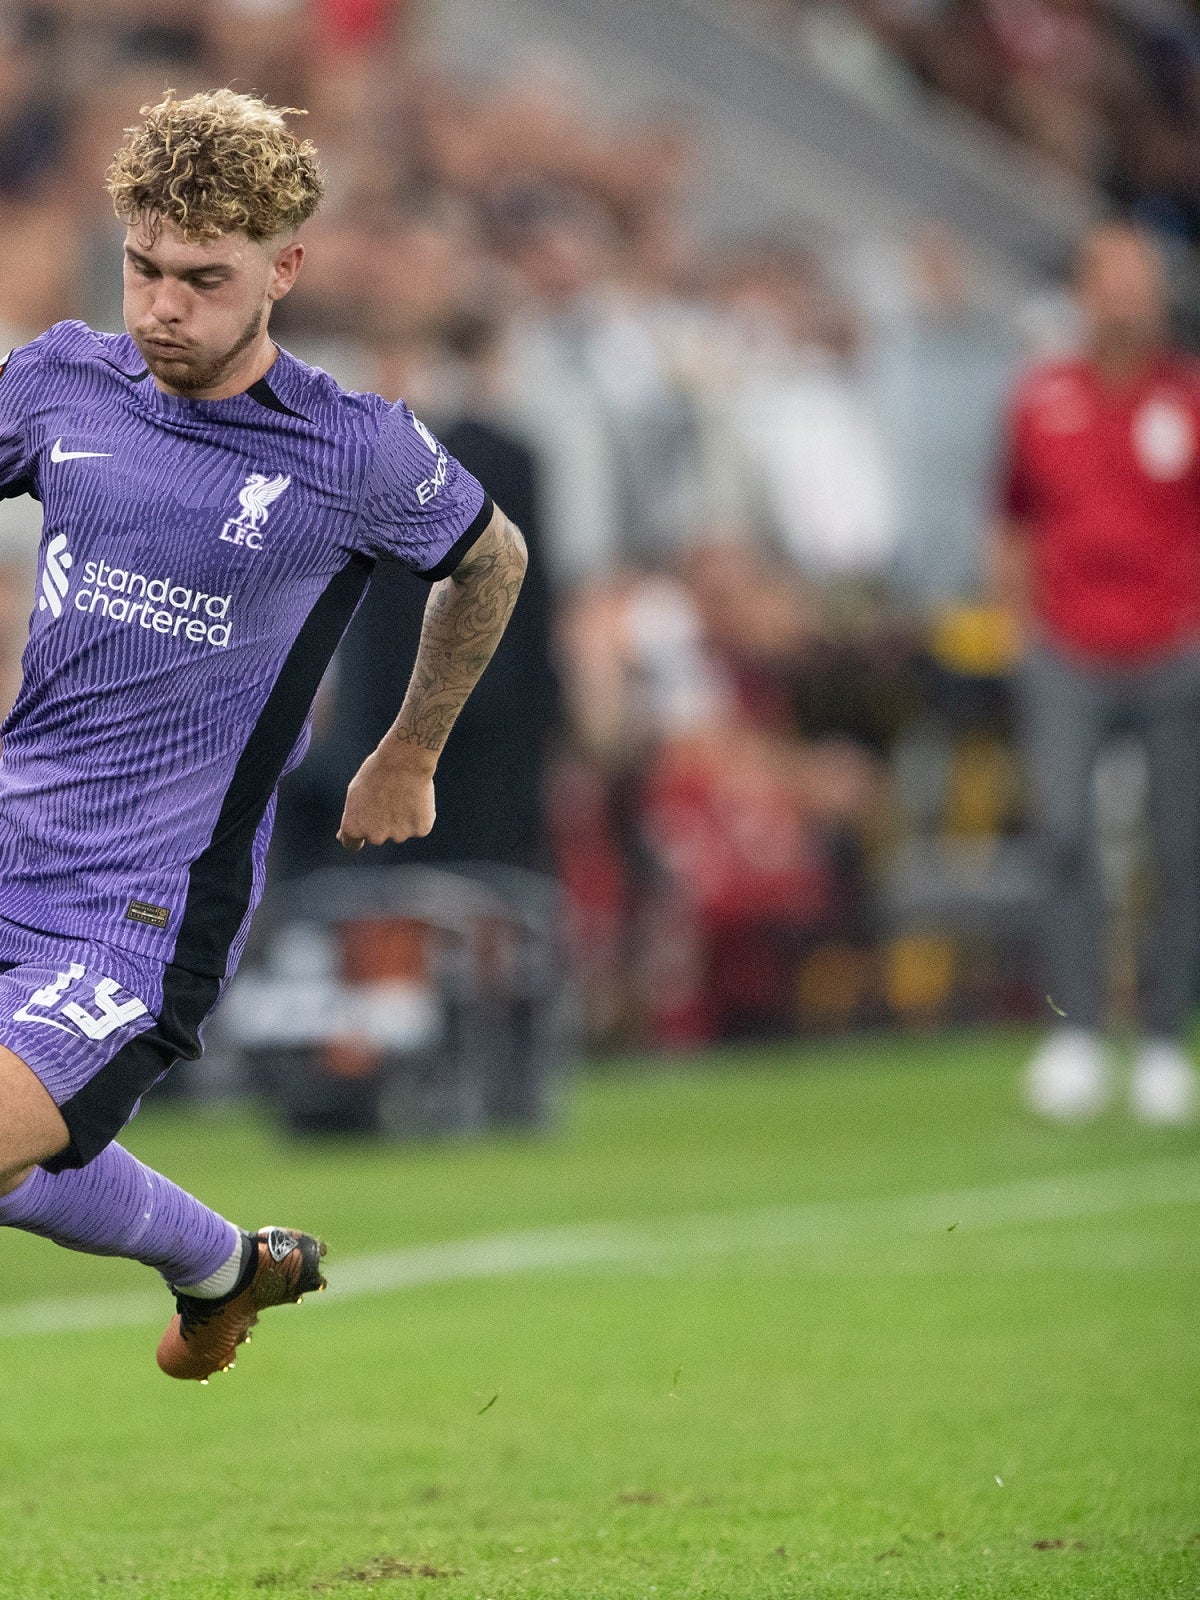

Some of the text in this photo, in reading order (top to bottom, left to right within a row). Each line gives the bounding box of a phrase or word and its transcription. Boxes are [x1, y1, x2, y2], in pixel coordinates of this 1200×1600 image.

[75, 587, 233, 648] chartered
[82, 559, 232, 619] standard
[12, 962, 149, 1040] 19
